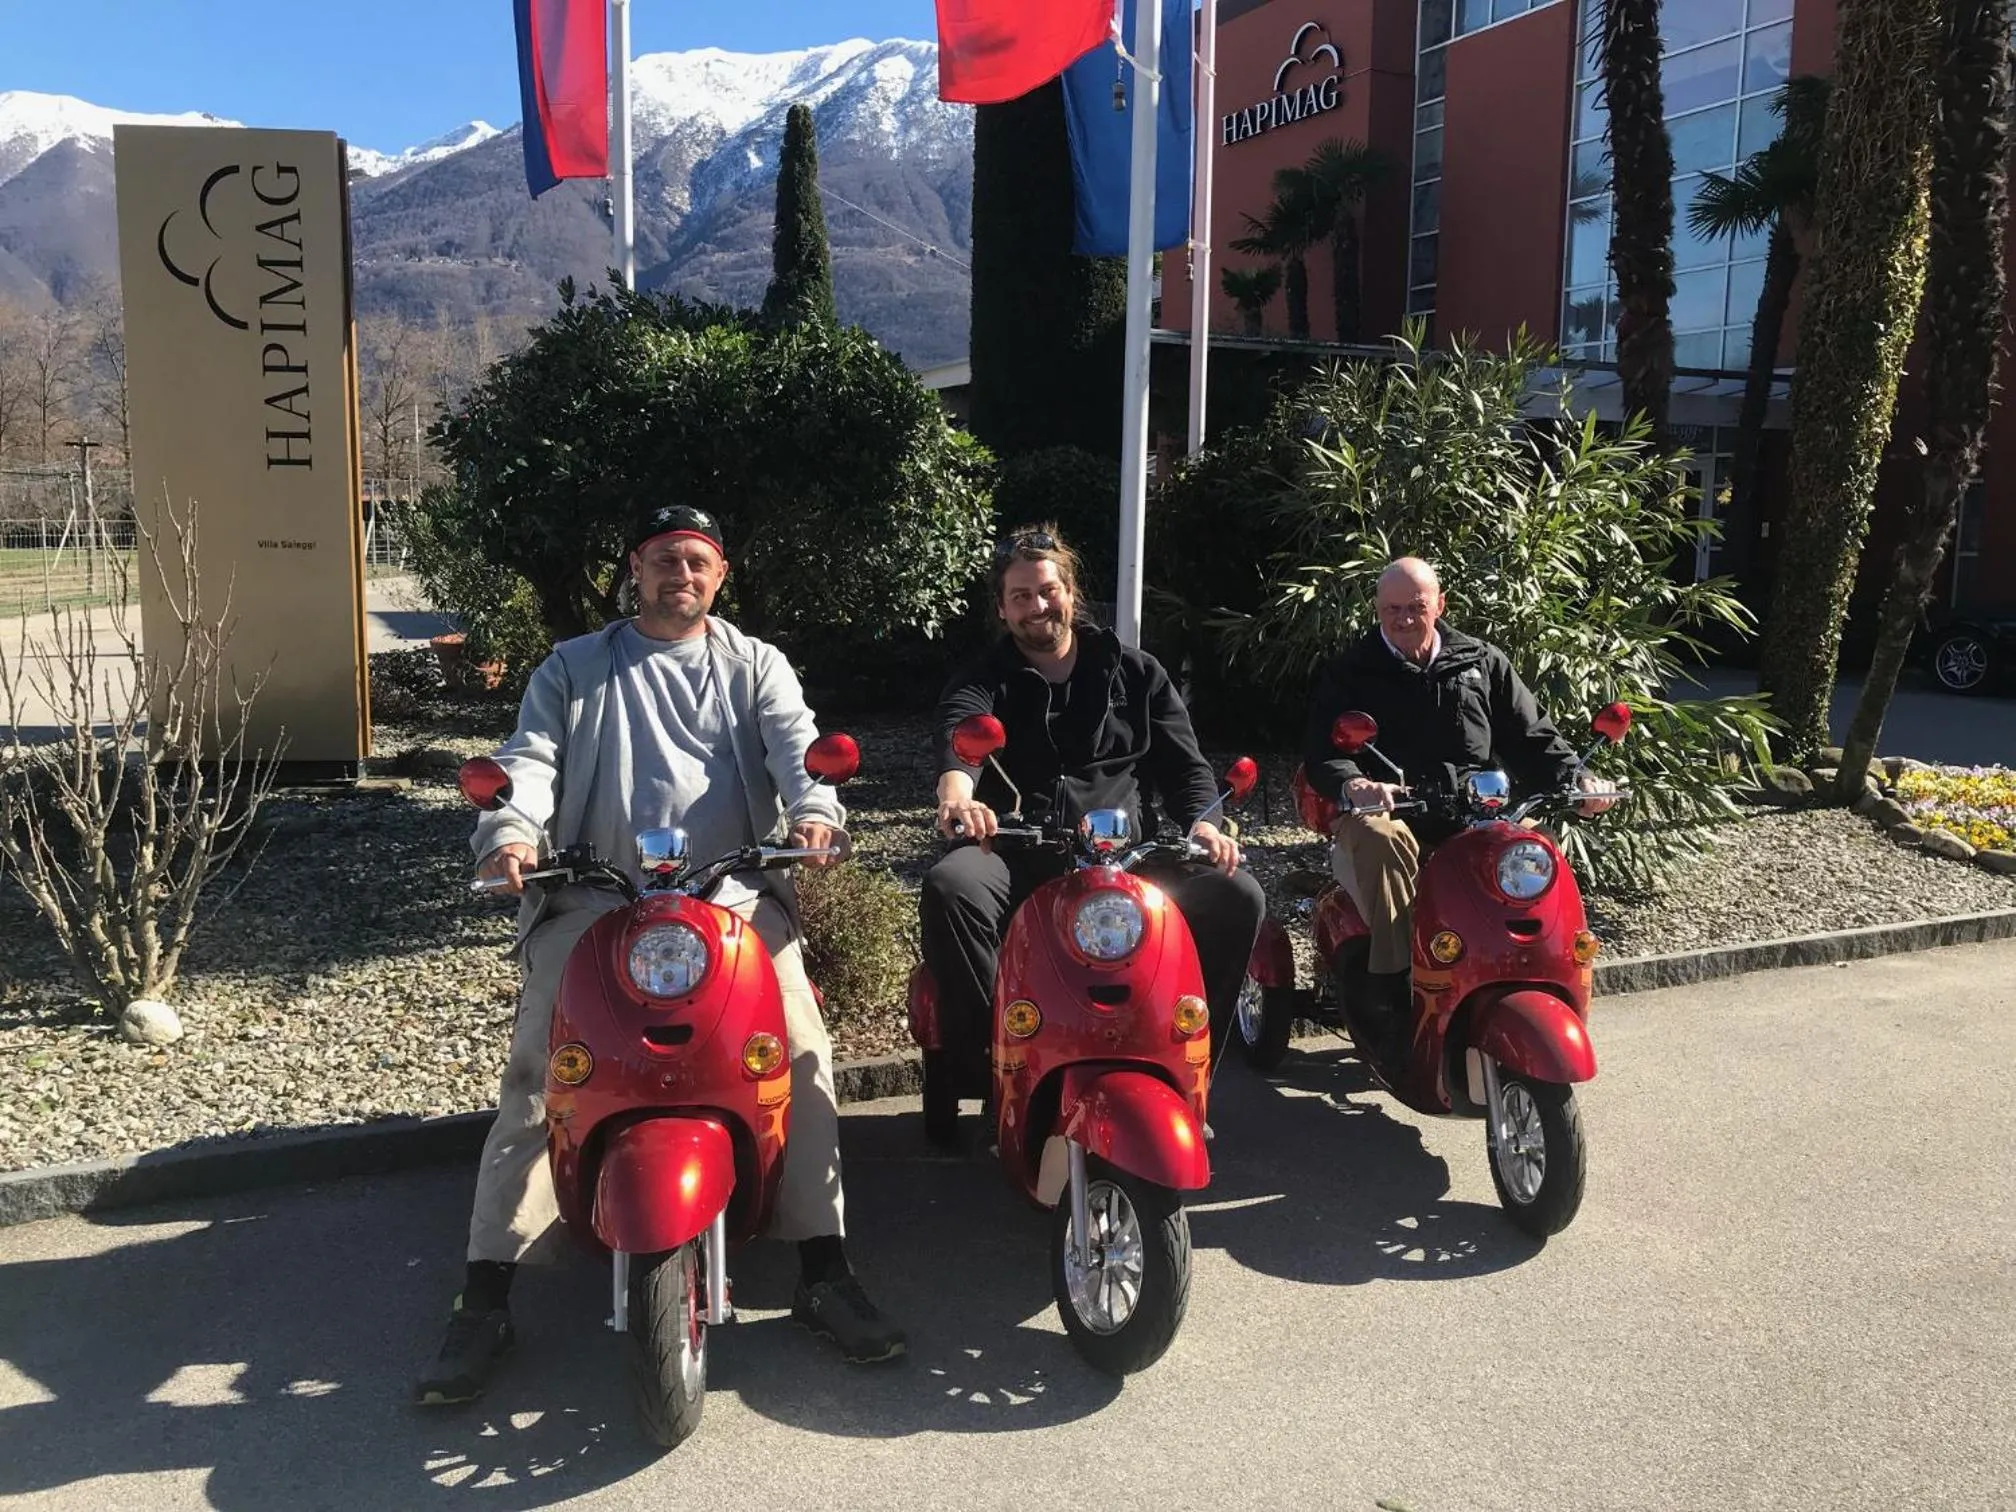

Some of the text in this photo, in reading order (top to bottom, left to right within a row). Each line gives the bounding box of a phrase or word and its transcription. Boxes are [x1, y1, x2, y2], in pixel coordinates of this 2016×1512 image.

[1222, 75, 1338, 146] HAPIMAG
[252, 161, 312, 471] HAPIMAG
[257, 540, 279, 549] Villa
